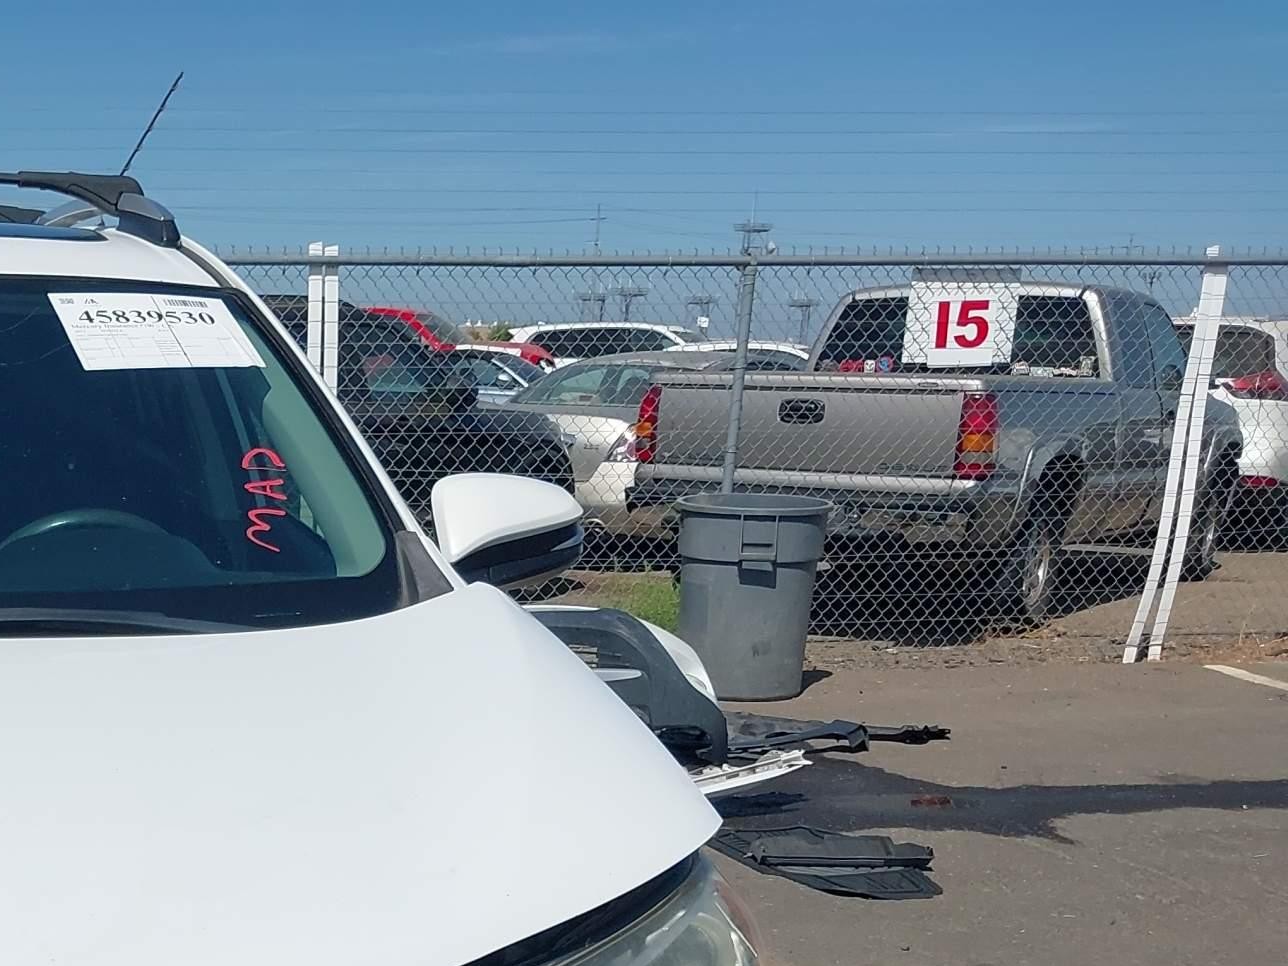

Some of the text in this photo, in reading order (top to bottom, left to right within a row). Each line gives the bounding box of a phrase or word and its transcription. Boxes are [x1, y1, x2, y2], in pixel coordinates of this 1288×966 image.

[79, 310, 215, 325] 45839530
[935, 300, 990, 349] 15
[241, 447, 288, 553] MAD
